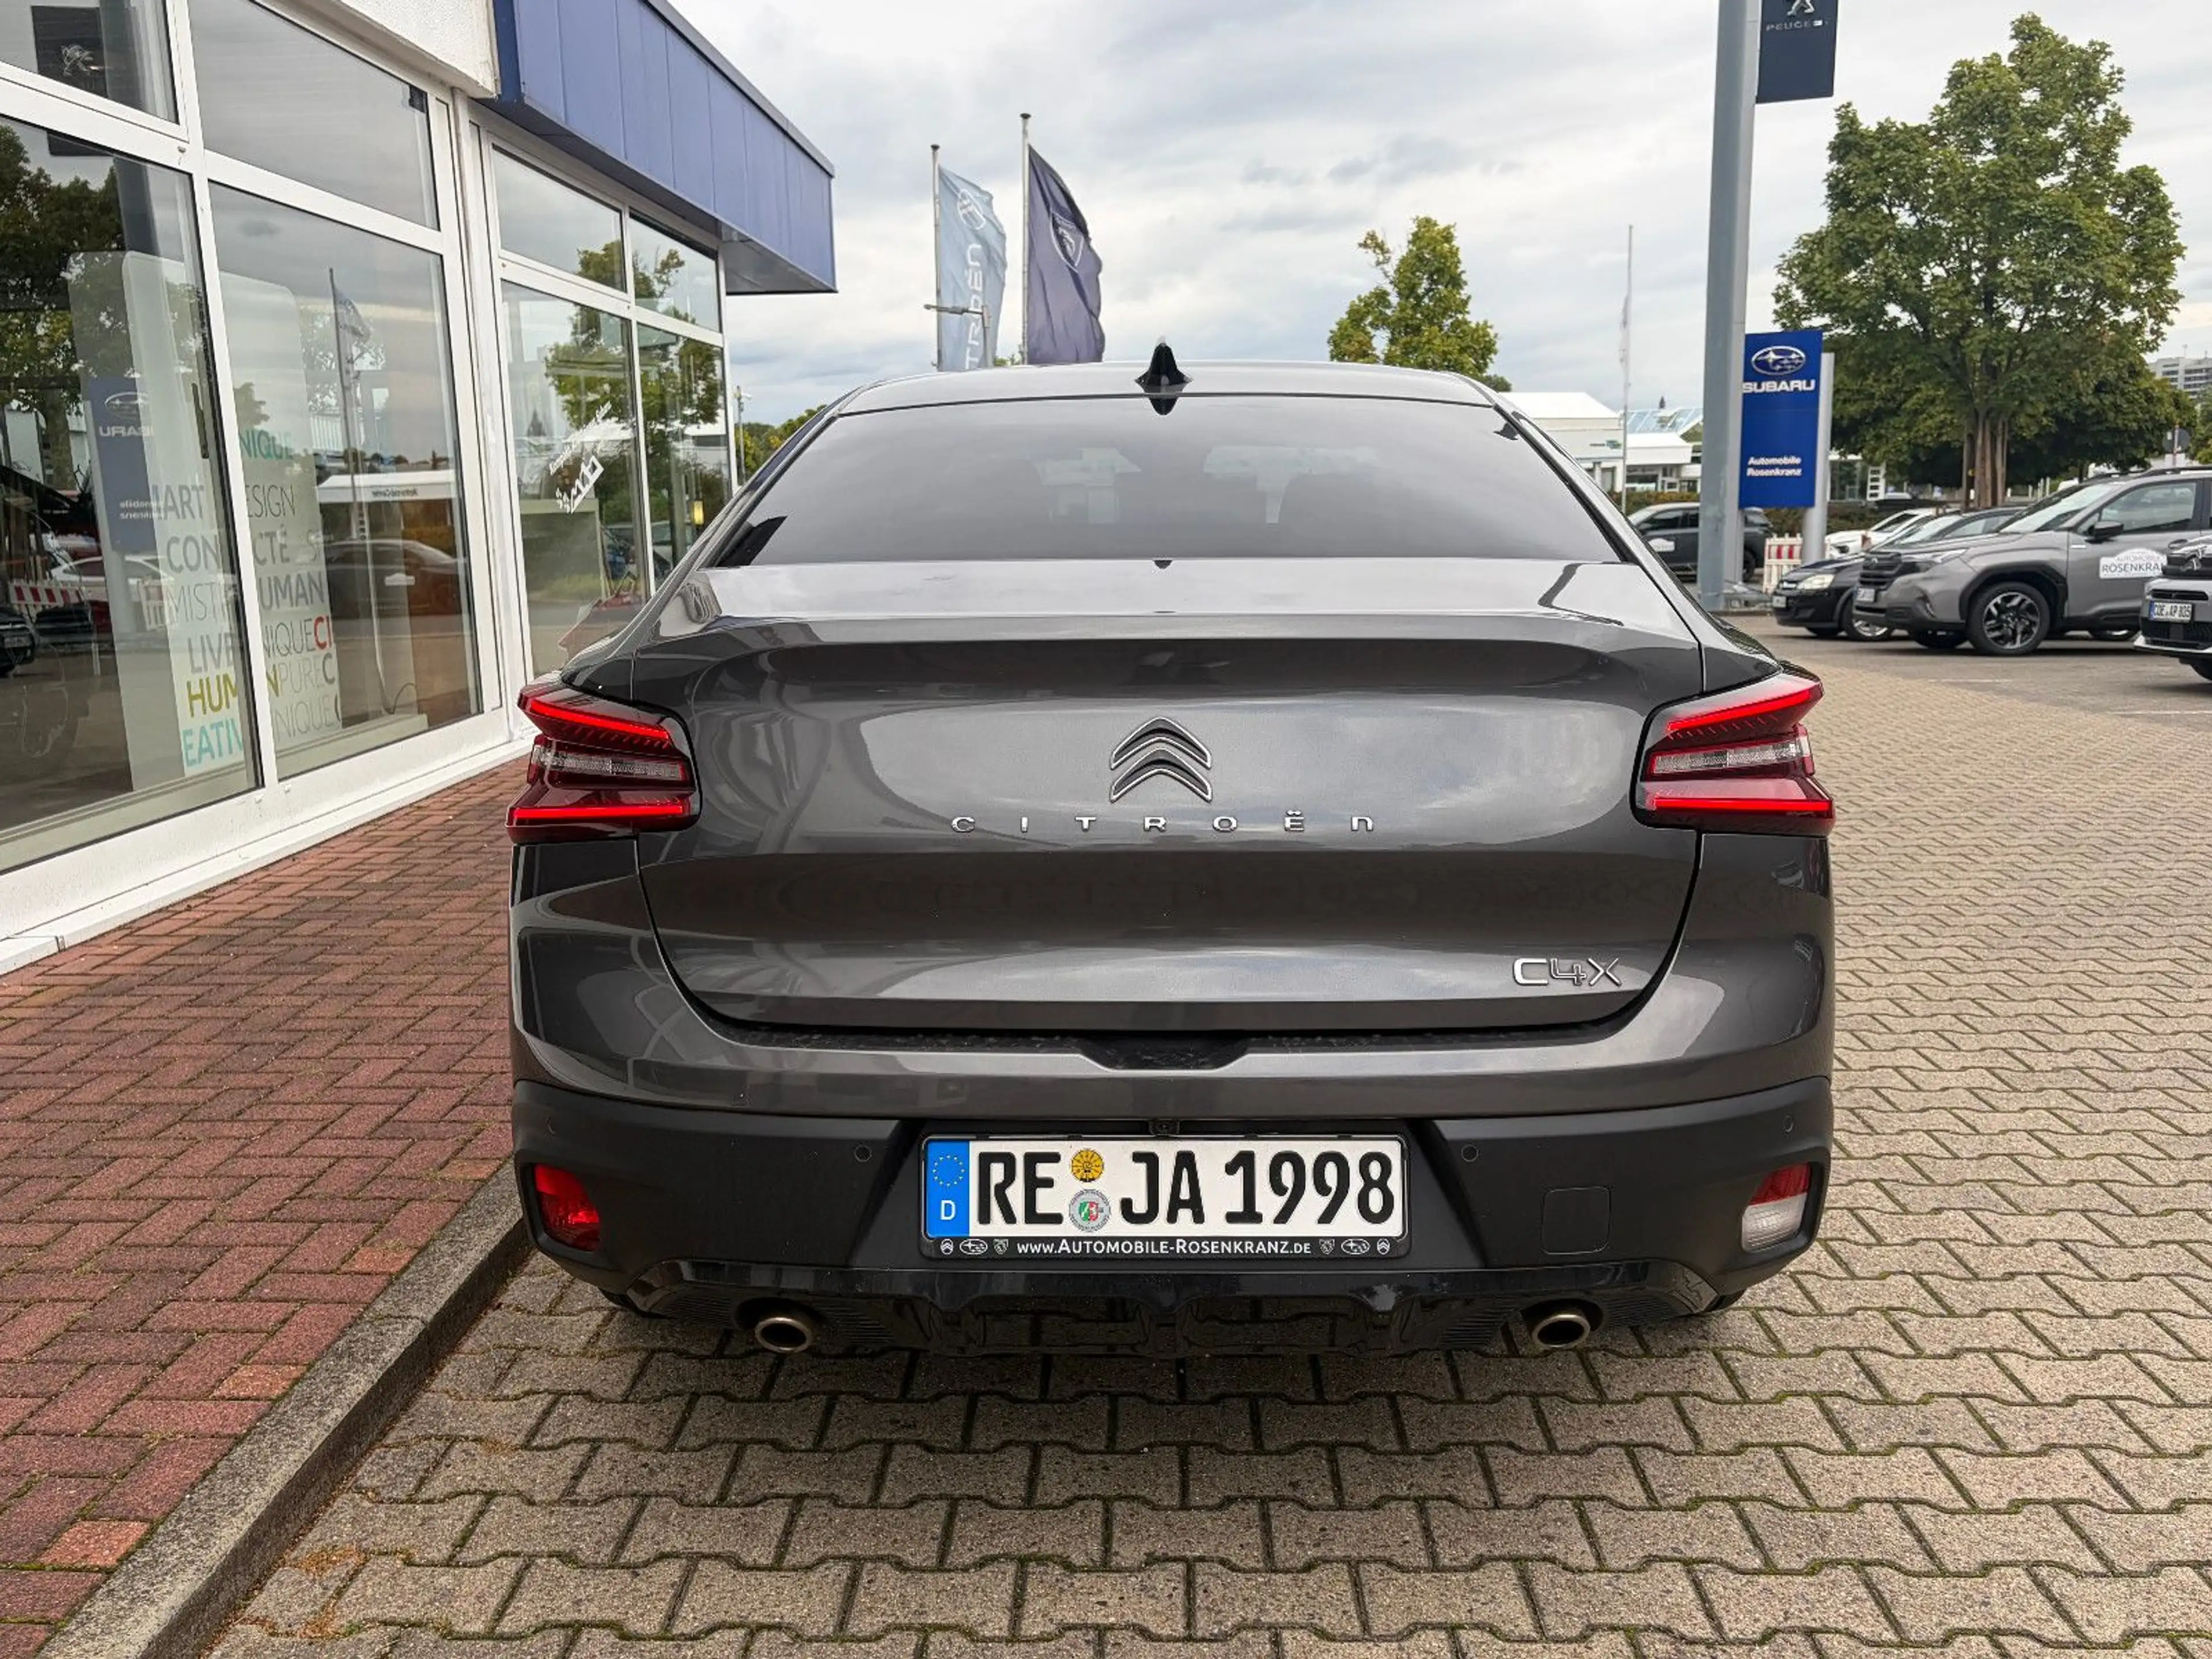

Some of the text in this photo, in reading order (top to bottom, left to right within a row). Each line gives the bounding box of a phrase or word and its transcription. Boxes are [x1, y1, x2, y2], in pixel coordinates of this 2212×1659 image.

[1742, 379, 1816, 393] SUBARU
[239, 430, 294, 460] NIQUE
[1748, 456, 1801, 465] Automobile
[1747, 468, 1802, 476] Rosenkranz
[259, 570, 325, 609] UMAN
[978, 1149, 1063, 1226] RE
[1120, 1149, 1206, 1226] JA
[1225, 1149, 1395, 1226] 1998
[940, 1199, 956, 1221] D
